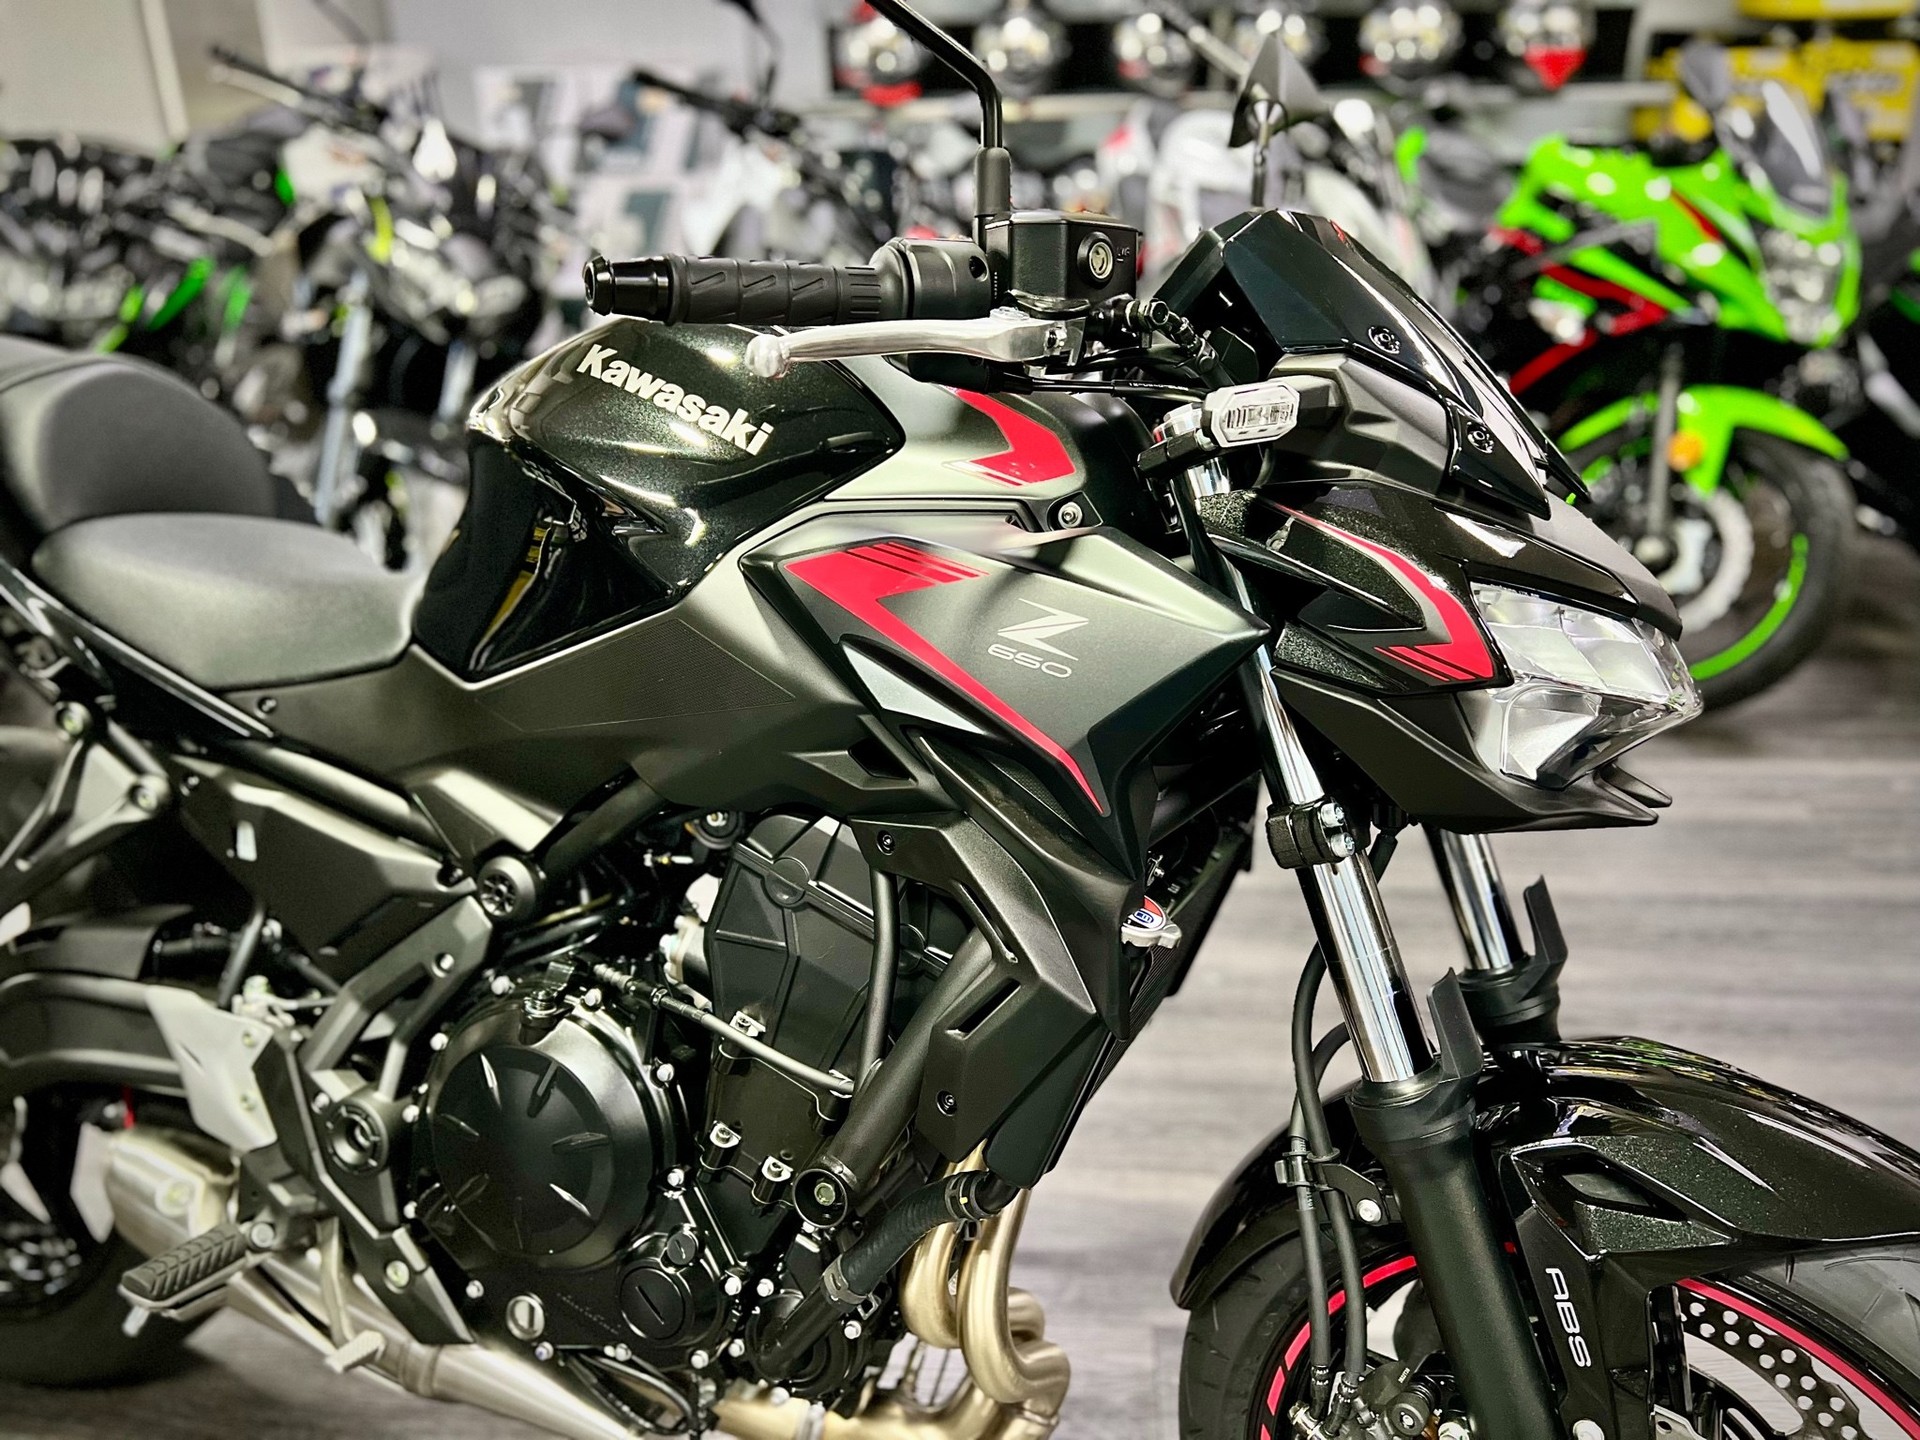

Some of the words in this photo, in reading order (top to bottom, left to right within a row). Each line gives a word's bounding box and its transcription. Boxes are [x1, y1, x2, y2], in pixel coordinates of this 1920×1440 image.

[576, 343, 775, 456] Kawasaki
[987, 643, 1073, 678] 650
[997, 597, 1089, 662] Z
[1545, 1267, 1592, 1368] ABS
